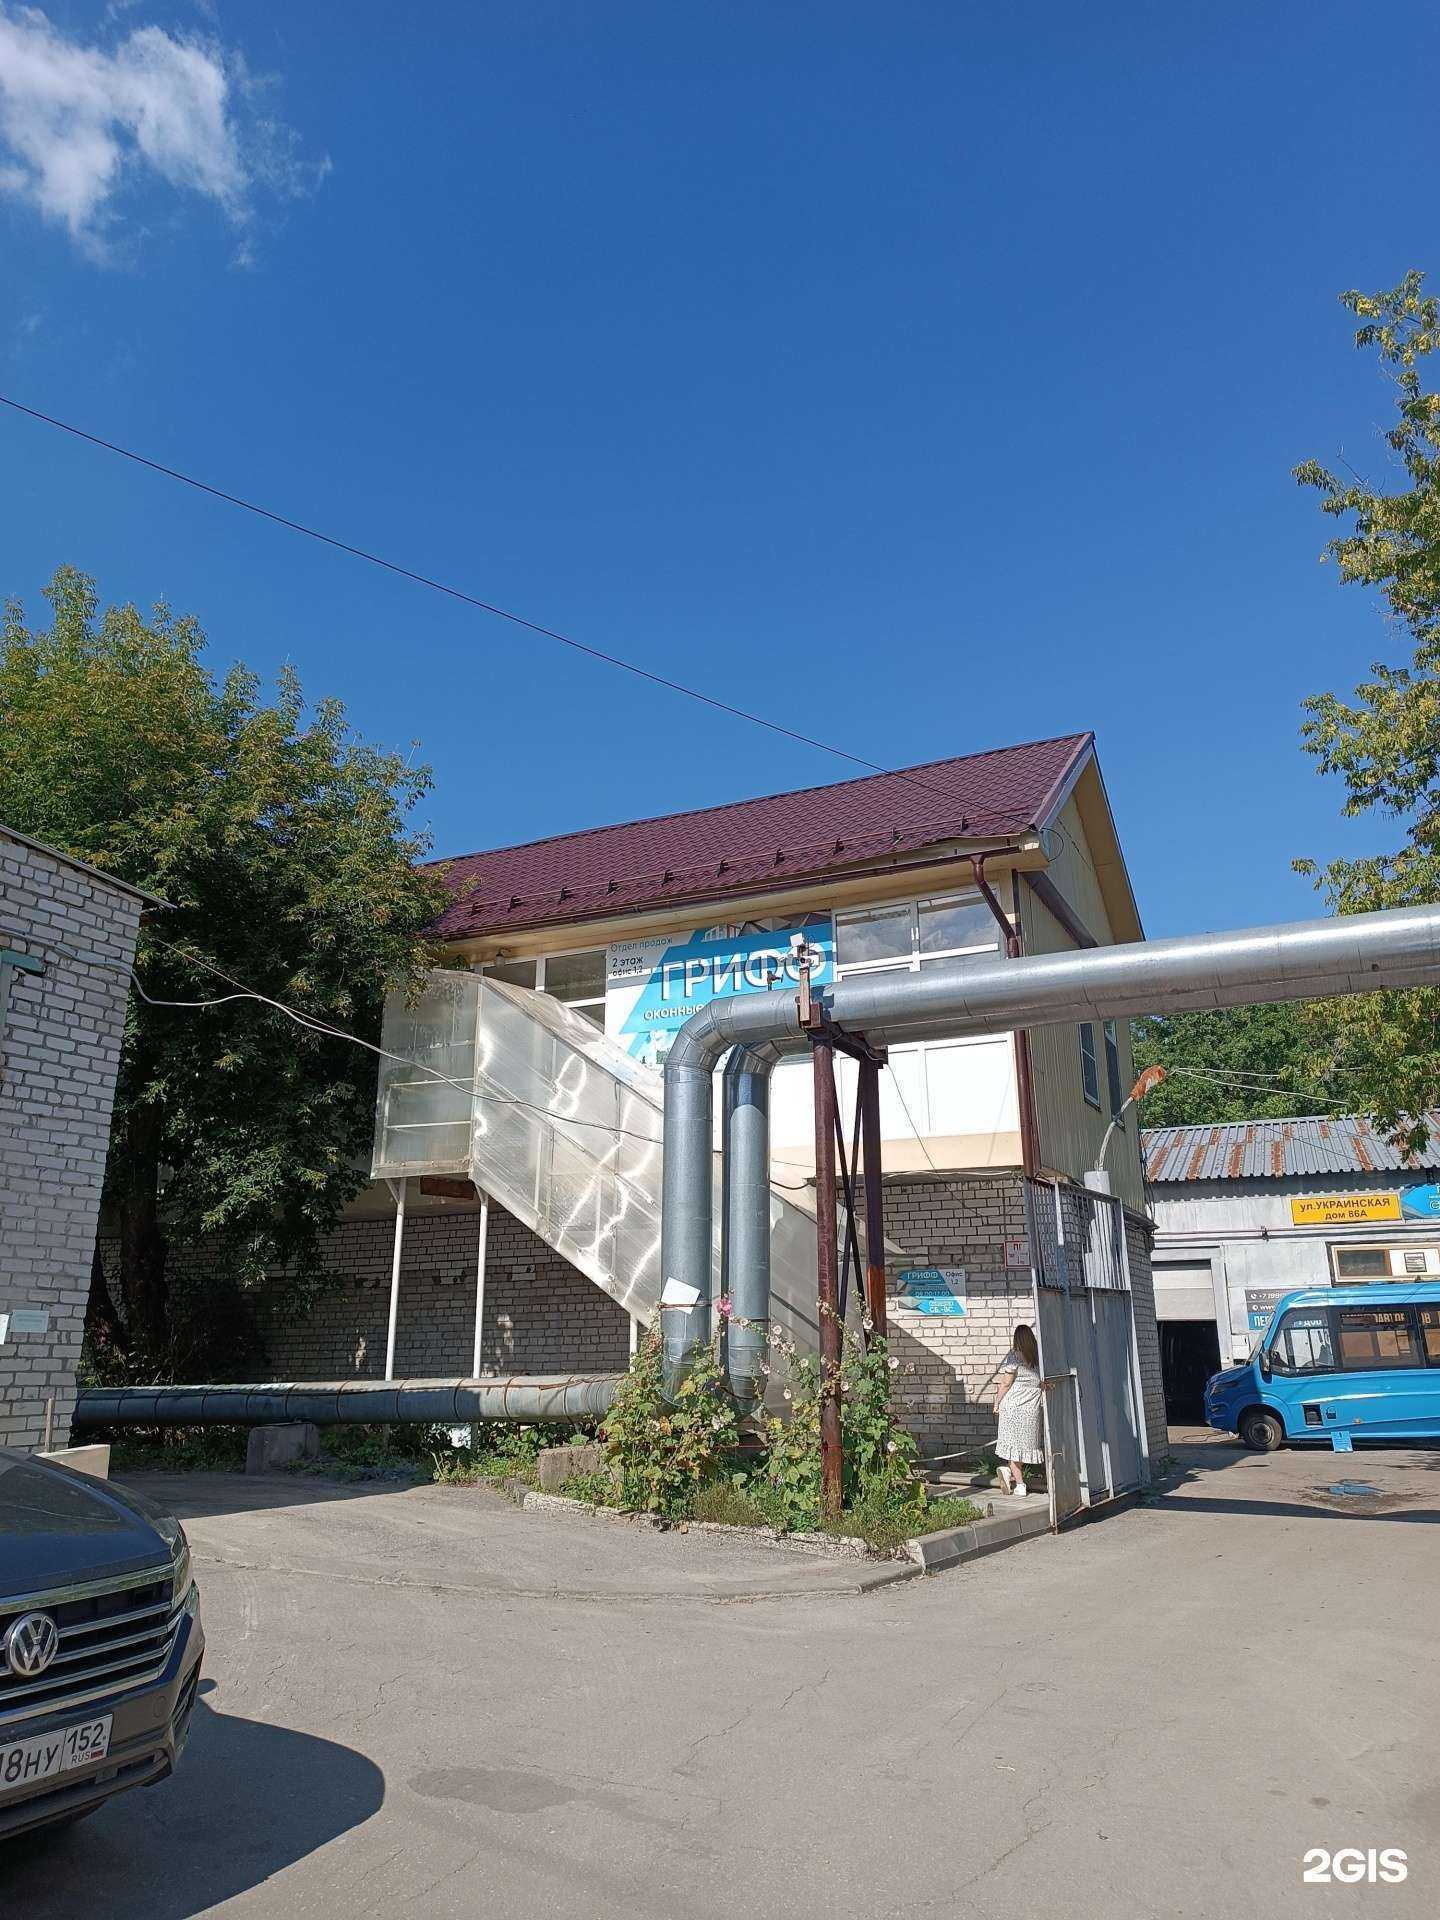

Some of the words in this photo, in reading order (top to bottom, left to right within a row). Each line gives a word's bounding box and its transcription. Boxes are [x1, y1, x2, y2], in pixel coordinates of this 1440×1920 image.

[610, 943, 637, 953] Отдел
[640, 936, 673, 949] продаж
[612, 957, 618, 968] 2
[620, 956, 644, 966] этаж
[612, 968, 631, 976] офис
[1325, 1212, 1346, 1221] дом
[1348, 1210, 1368, 1218] 86А
[907, 1271, 939, 1280] ГРИФФ
[67, 1722, 104, 1755] 152
[72, 1751, 91, 1764] RUS
